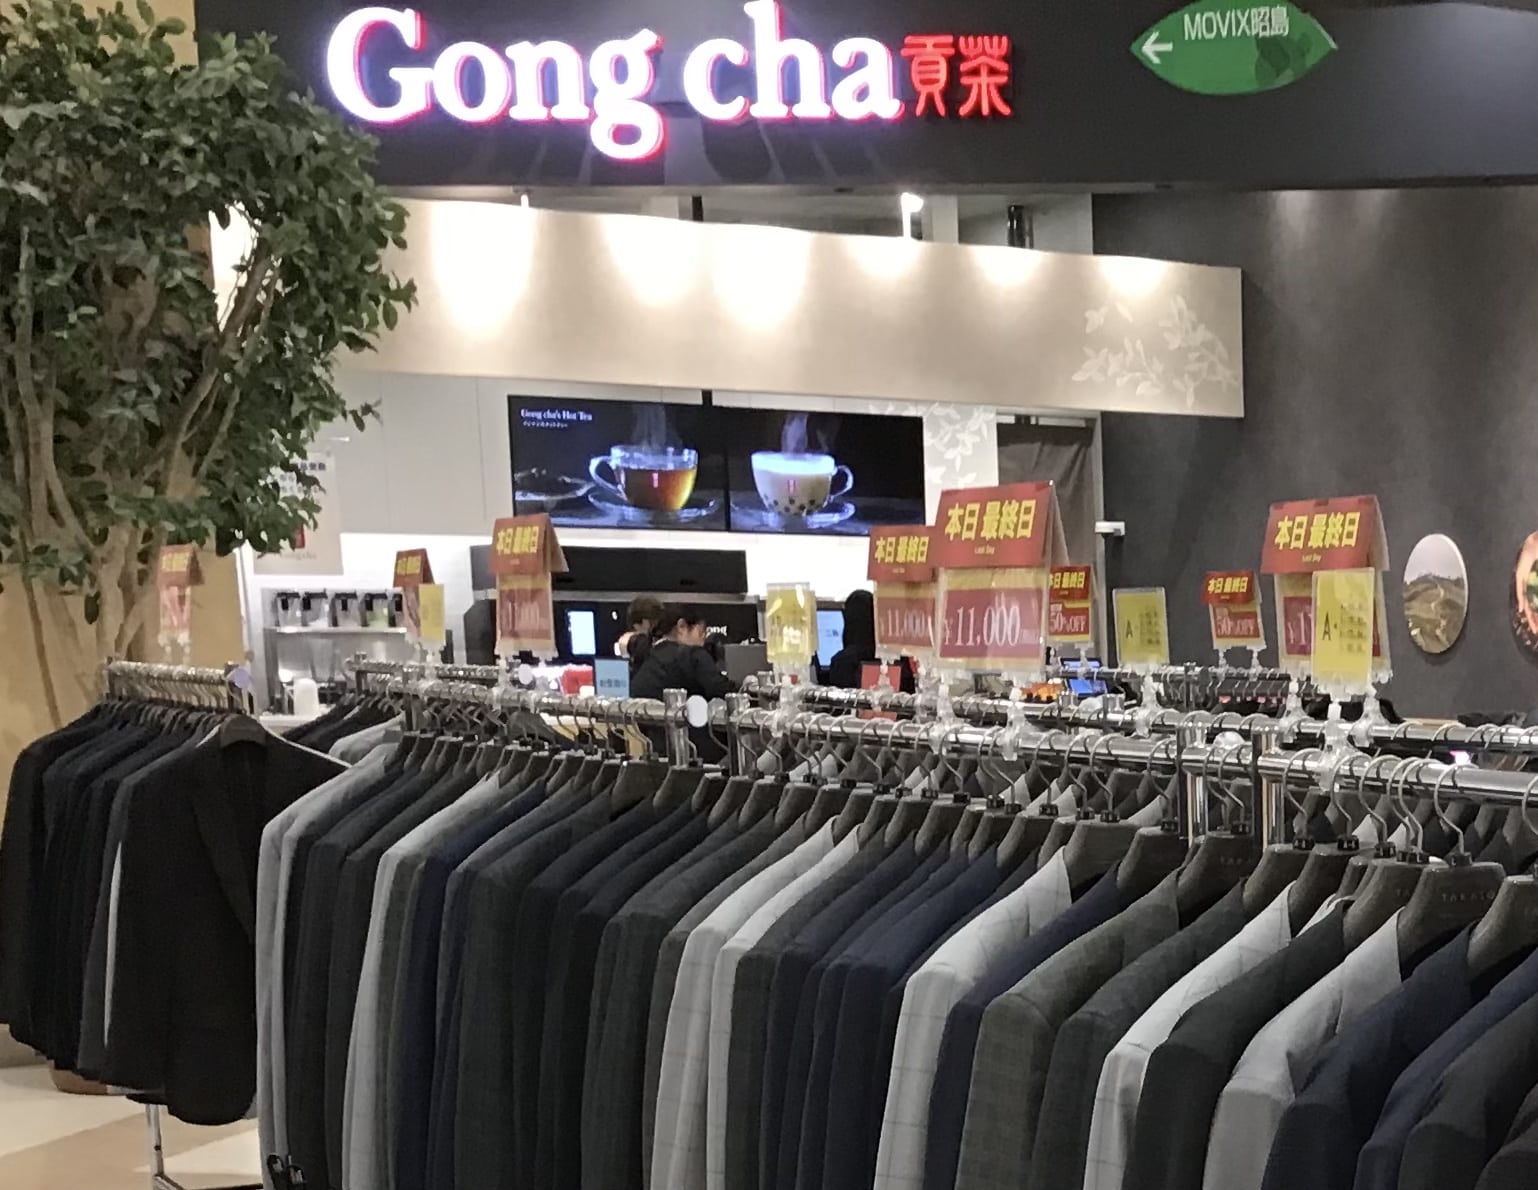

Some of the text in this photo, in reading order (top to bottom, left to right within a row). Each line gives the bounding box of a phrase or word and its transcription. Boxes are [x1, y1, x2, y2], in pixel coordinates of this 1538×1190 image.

[1183, 5, 1290, 41] MOVIX昭島
[325, 0, 905, 160] Gong cha
[901, 33, 1012, 118] 貢茶
